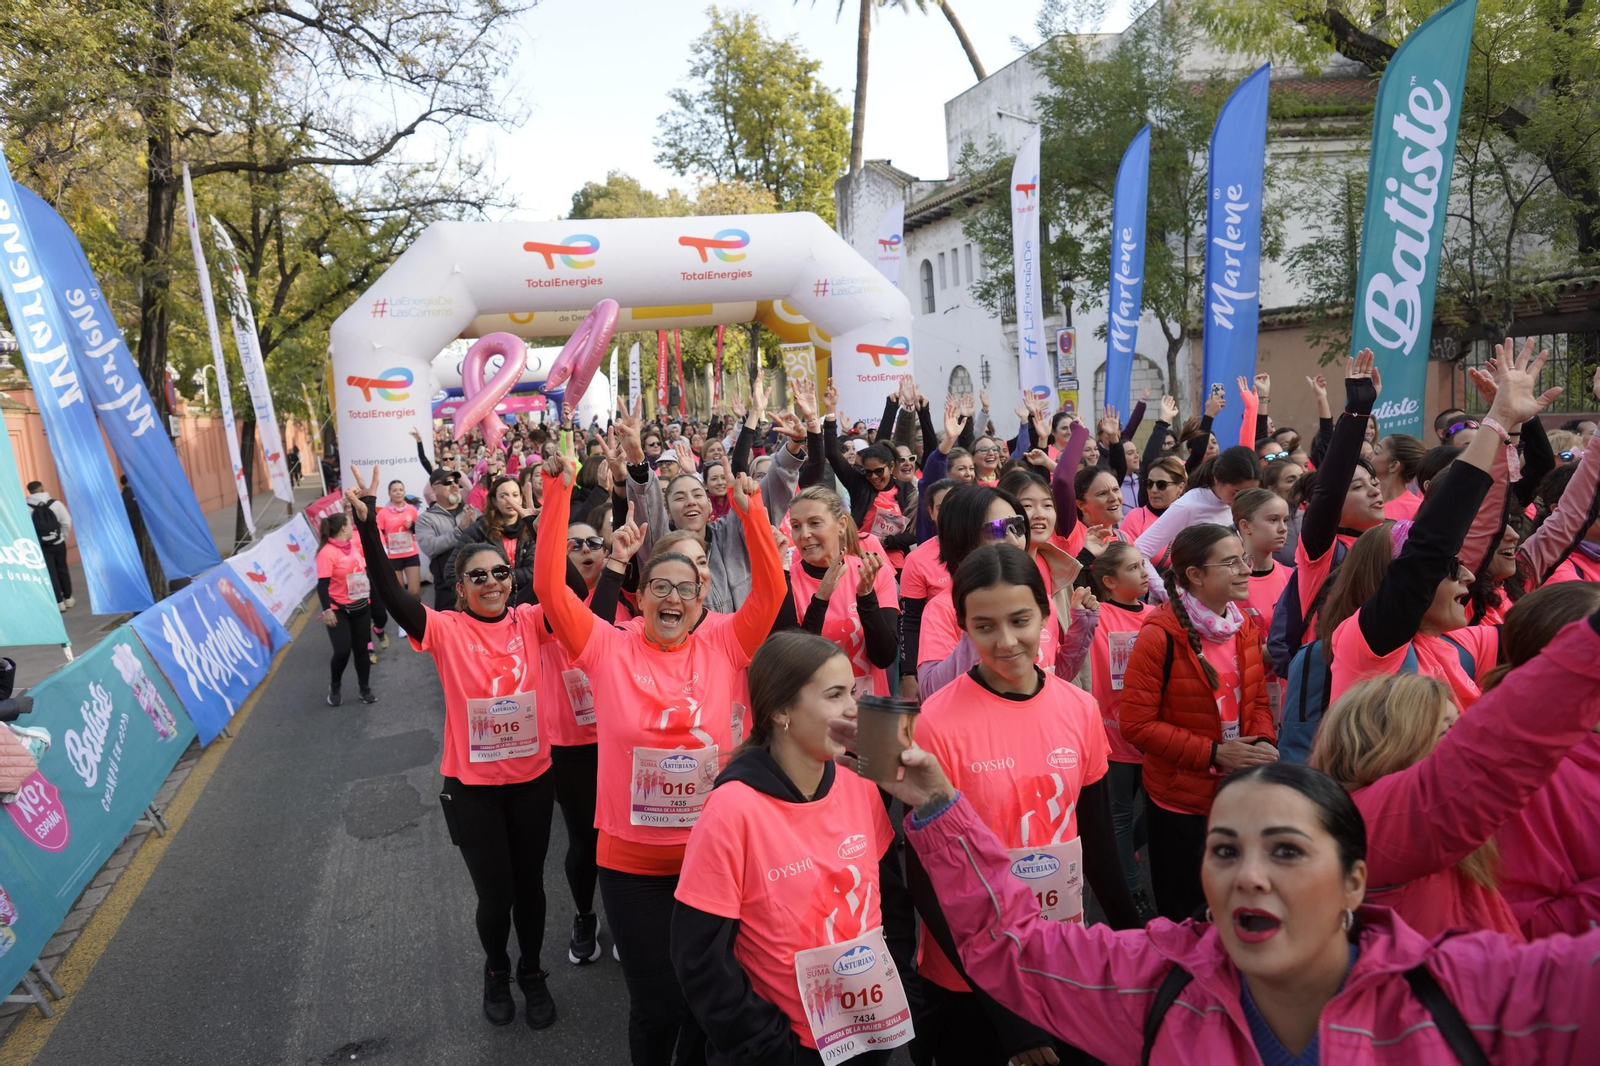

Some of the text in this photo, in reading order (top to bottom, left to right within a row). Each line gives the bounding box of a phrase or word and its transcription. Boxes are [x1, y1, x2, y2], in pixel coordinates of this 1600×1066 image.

[1365, 79, 1451, 356] Batiste
[1211, 184, 1257, 330] Marlene
[525, 276, 603, 288] TotalEnergies
[680, 269, 753, 281] TotalEnergies
[1112, 227, 1140, 353] Marlene
[348, 407, 416, 419] TotalEnergies
[1371, 397, 1419, 420] atiste
[1384, 416, 1419, 429] EN SECO
[161, 588, 259, 716] Marlene
[493, 721, 520, 734] 016
[662, 761, 697, 769] ASTURIANA
[971, 757, 1015, 774] OYSHO
[662, 782, 696, 796] 016
[34, 809, 63, 840] ESPAÑA
[640, 814, 669, 823] OYSHO
[842, 841, 867, 857] ASTURIAN
[767, 857, 814, 882] OYSHO
[1014, 863, 1058, 874] ASTURIANA
[1035, 889, 1059, 909] 16
[837, 953, 875, 973] ASTURIANA
[806, 970, 831, 979] SUMA
[840, 984, 884, 1010] 016
[853, 1013, 876, 1024] 7434
[824, 1030, 846, 1044] CARRERA
[845, 1027, 853, 1035] DE
[862, 1023, 882, 1032] MUJER
[885, 1015, 902, 1026] SEVILLA
[877, 1028, 907, 1044] Santander
[825, 1040, 855, 1062] OYSHO
